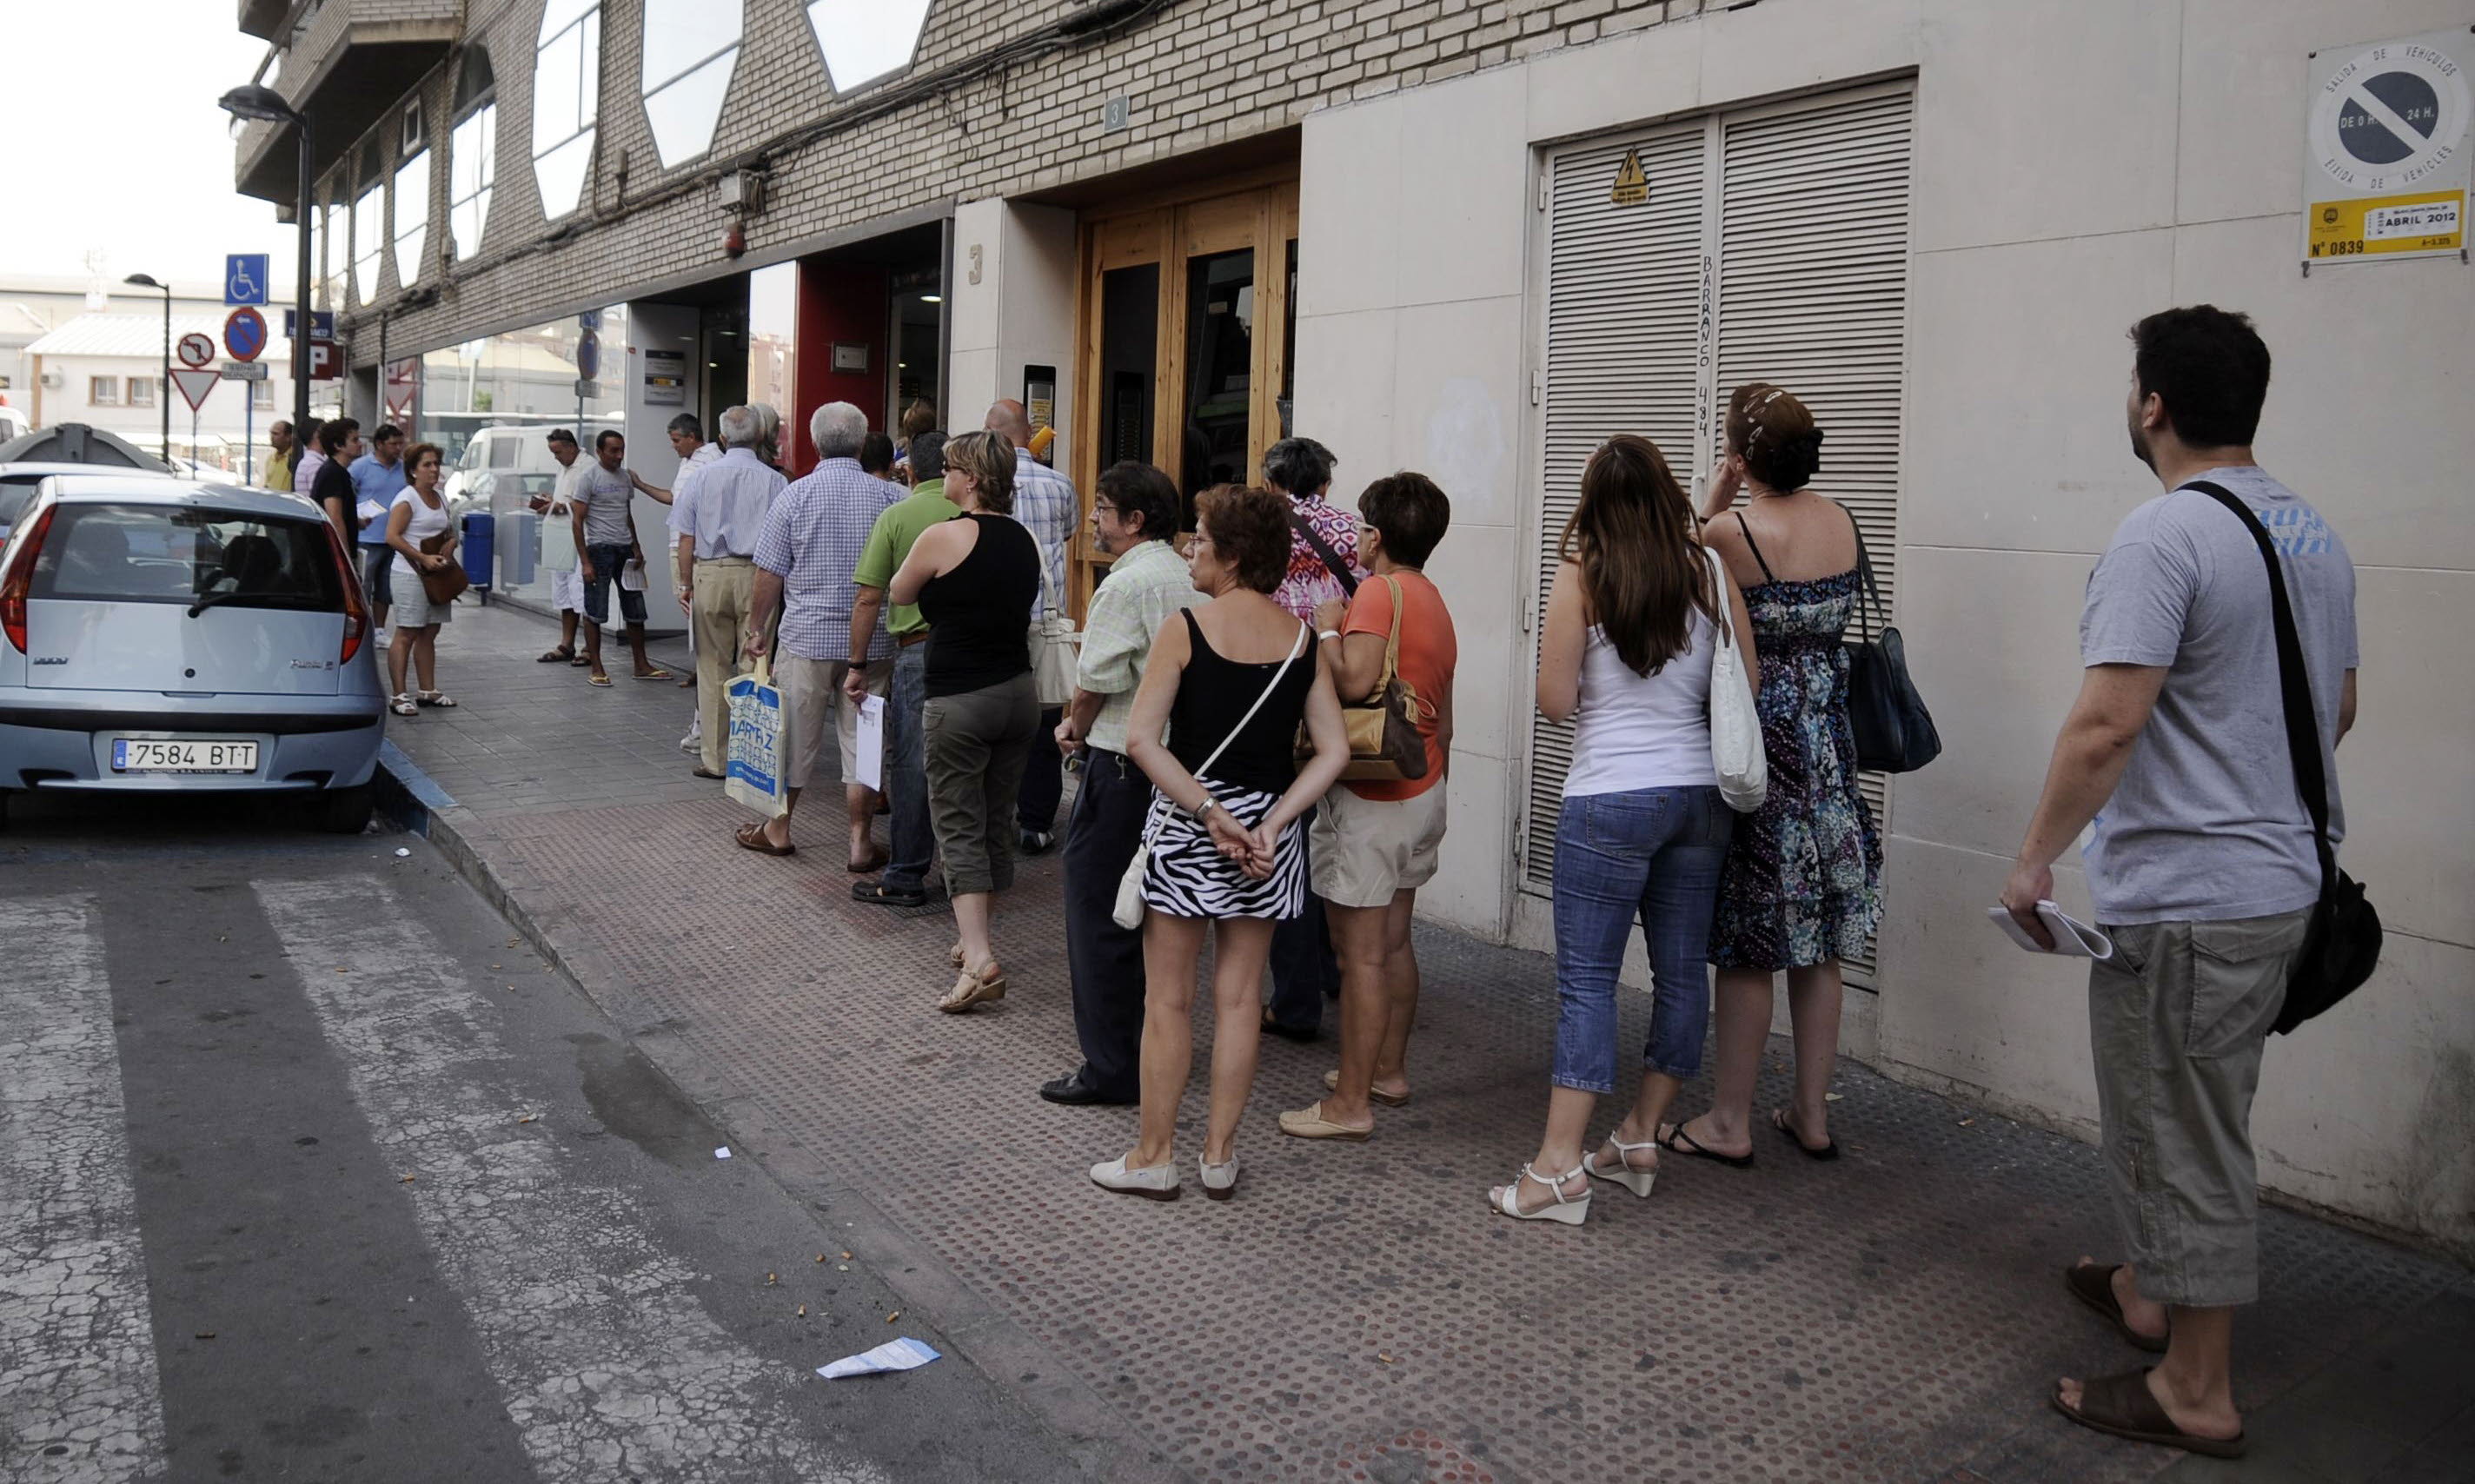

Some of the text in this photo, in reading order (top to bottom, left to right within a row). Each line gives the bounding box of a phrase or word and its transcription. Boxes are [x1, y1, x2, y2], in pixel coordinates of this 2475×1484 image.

[2326, 46, 2458, 93] SALIDA DE VEHICULOS
[1111, 103, 1119, 123] 3
[2340, 116, 2354, 129] DE
[2407, 108, 2420, 121] 24
[2324, 145, 2453, 189] EIXIDA DE VEHICLES
[2385, 215, 2421, 227] ABRIL
[2427, 212, 2456, 223] 2012
[2330, 240, 2364, 255] 0839
[969, 243, 983, 285] 3
[1698, 255, 1713, 437] BARRANCO 484
[309, 345, 328, 375] P
[136, 745, 254, 765] 7584 BTT
